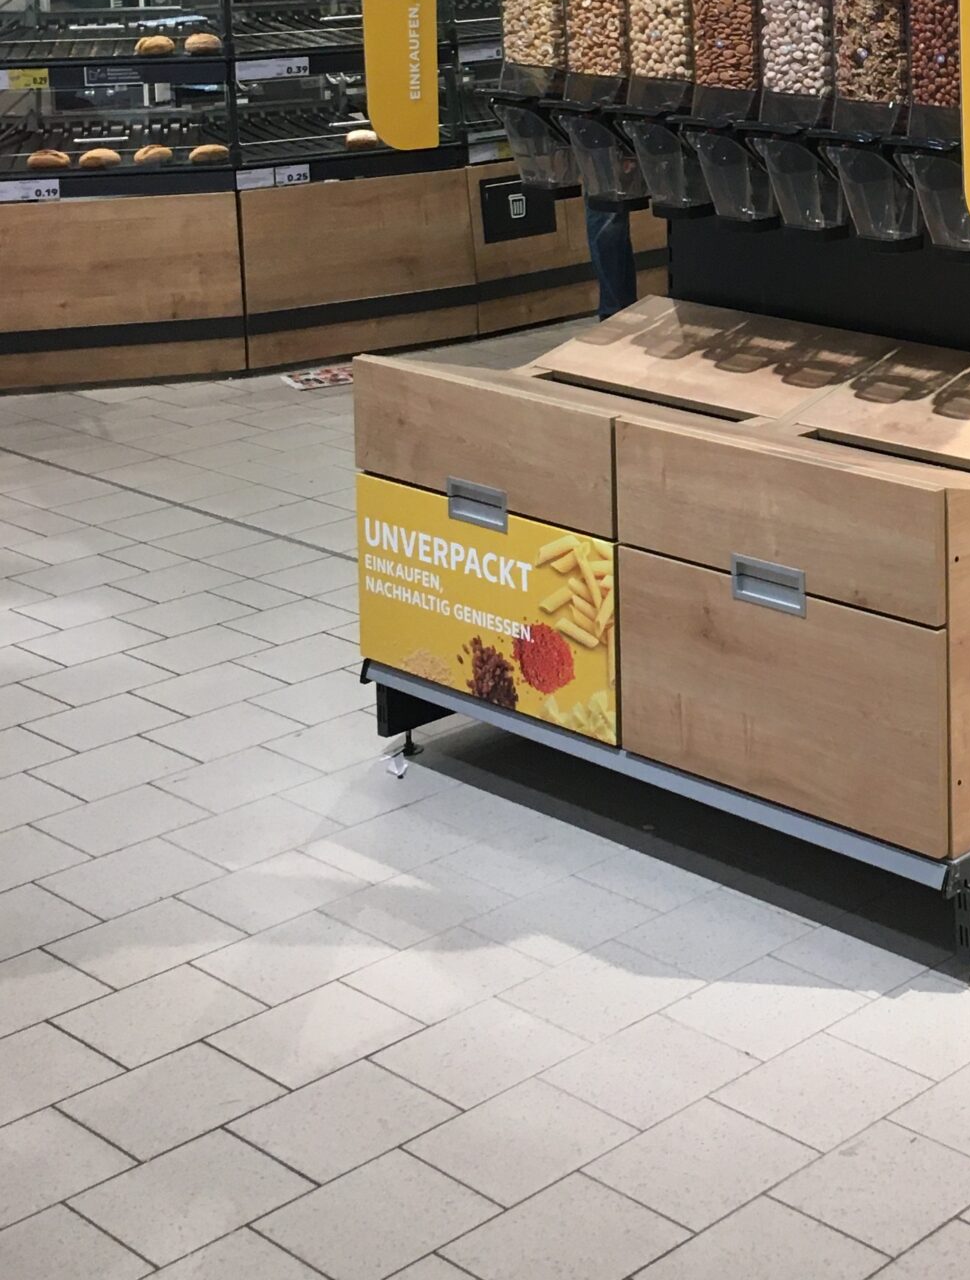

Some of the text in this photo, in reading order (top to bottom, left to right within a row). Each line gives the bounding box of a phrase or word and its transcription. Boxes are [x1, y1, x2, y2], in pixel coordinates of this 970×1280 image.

[286, 66, 308, 75] 0.39
[409, 2, 422, 101] EINKAUFEN,
[35, 188, 58, 198] 0.19
[287, 172, 308, 182] 0.25
[364, 517, 533, 593] UNVERPACKT
[364, 554, 444, 593] EINKAUFEN,
[365, 575, 535, 643] NACHHALTIG GENIESSEN.
